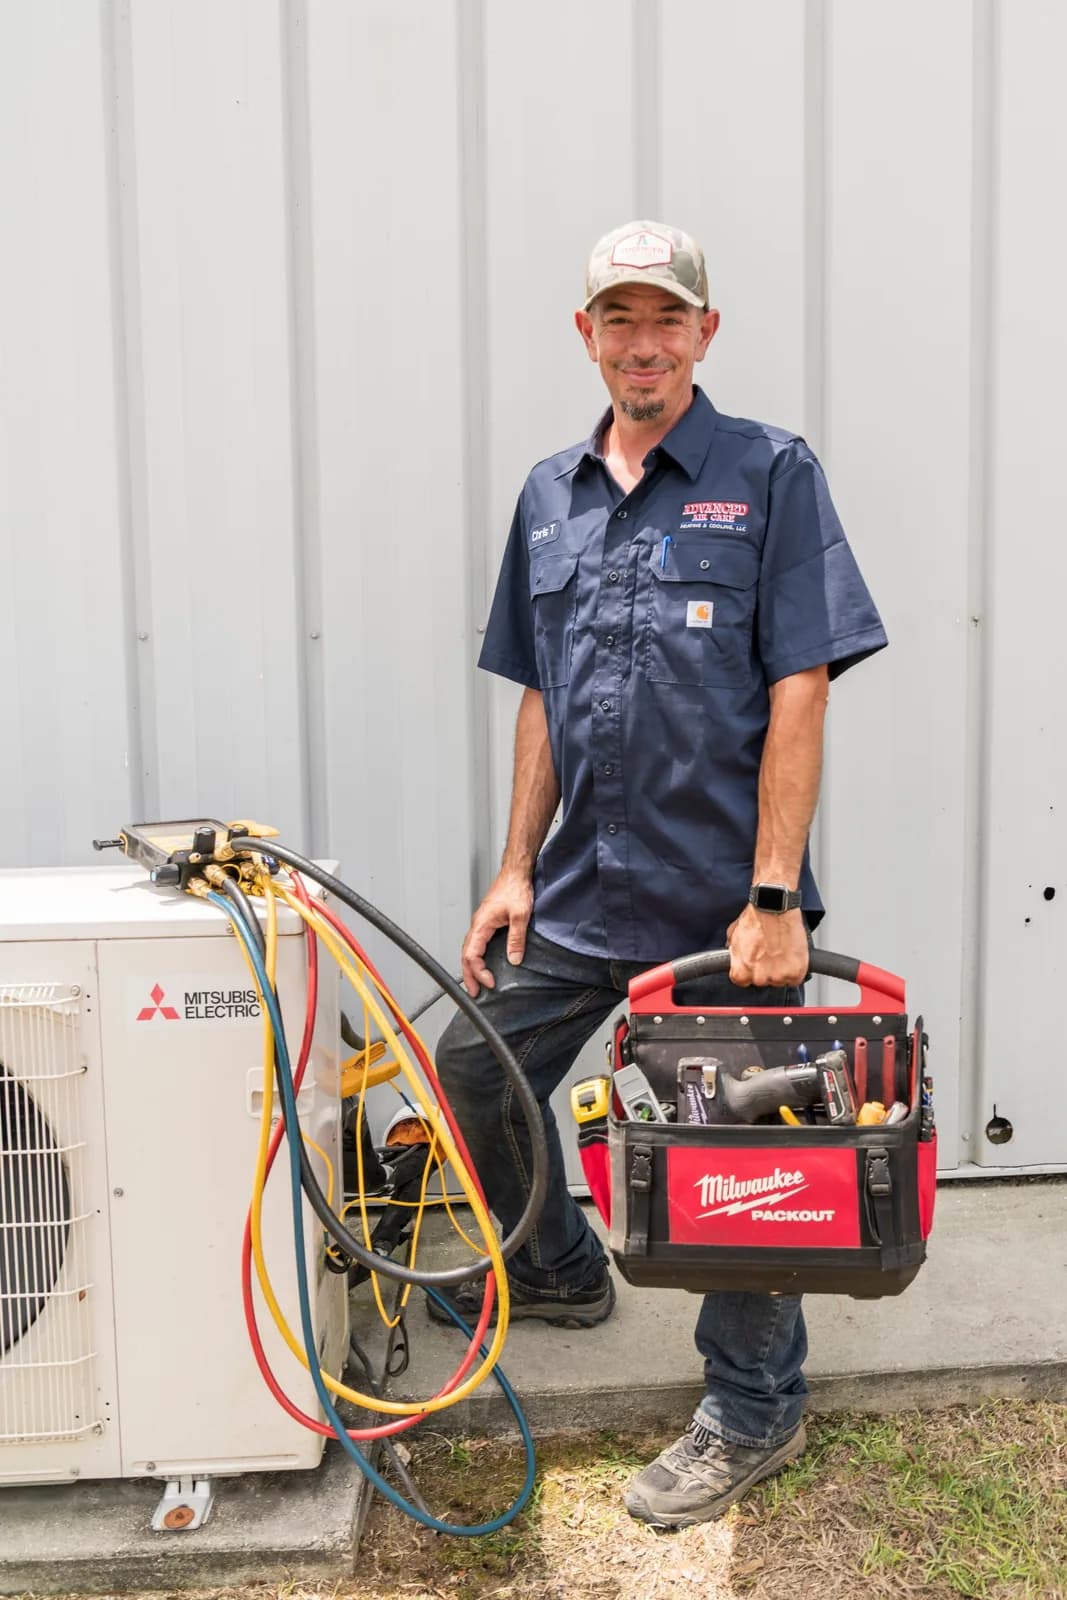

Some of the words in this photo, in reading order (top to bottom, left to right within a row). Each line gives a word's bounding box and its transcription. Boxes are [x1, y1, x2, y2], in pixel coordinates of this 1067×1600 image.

[682, 501, 749, 515] ADVANCED
[710, 514, 736, 522] CARE
[532, 527, 549, 541] Chris
[550, 523, 556, 535] T
[185, 1004, 260, 1019] ELECTRIC
[694, 1168, 805, 1207] Milwaukee
[752, 1210, 835, 1222] PACKOUT
